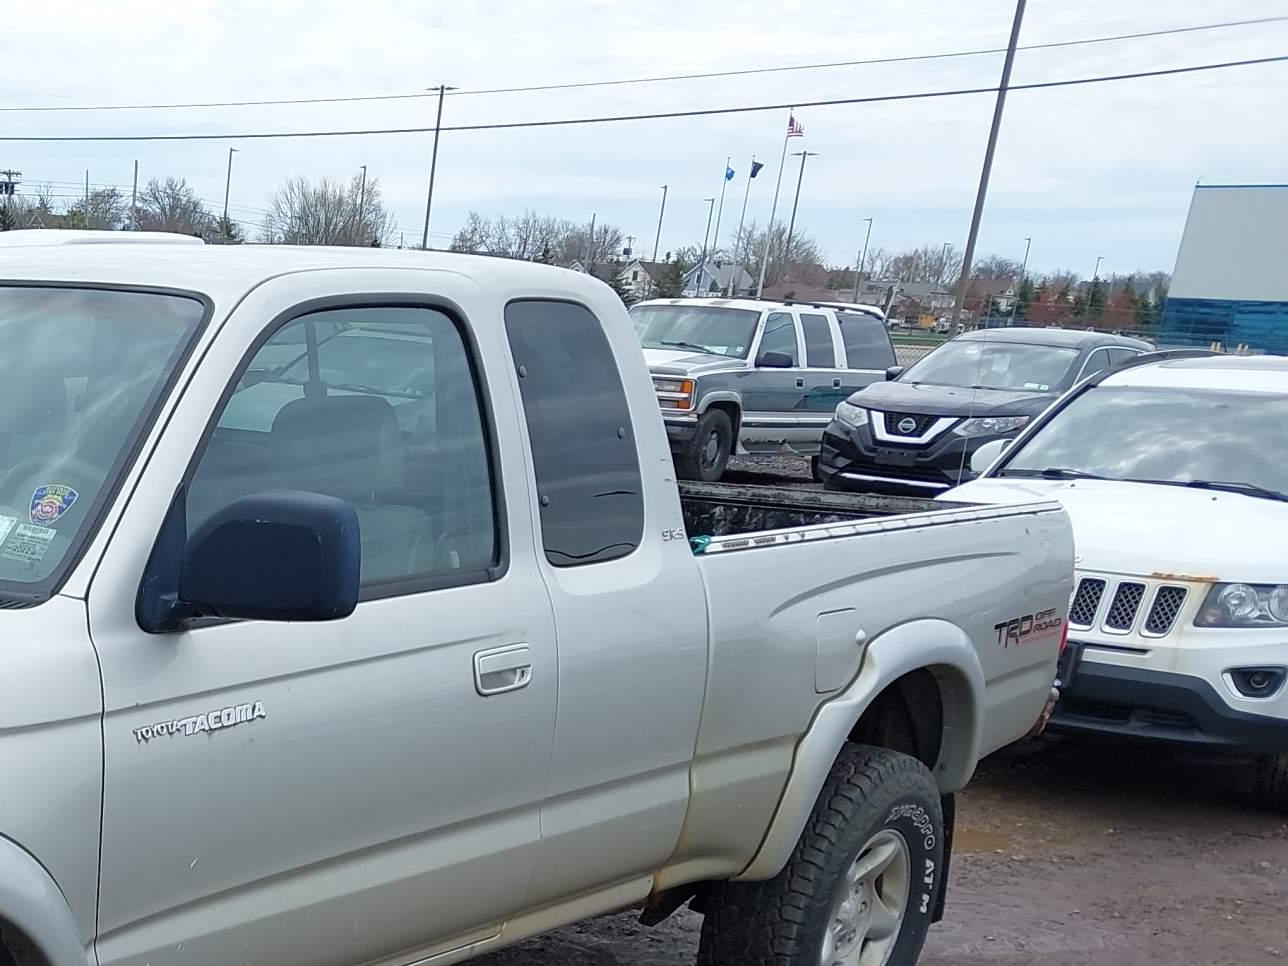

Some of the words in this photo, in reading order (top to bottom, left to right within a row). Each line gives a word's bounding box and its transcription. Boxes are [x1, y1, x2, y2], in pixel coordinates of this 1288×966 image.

[1033, 617, 1062, 632] ROAD
[1035, 607, 1057, 620] OFF
[994, 614, 1034, 648] TRD
[132, 720, 181, 743] TOYOTA
[181, 701, 266, 736] TACOMA
